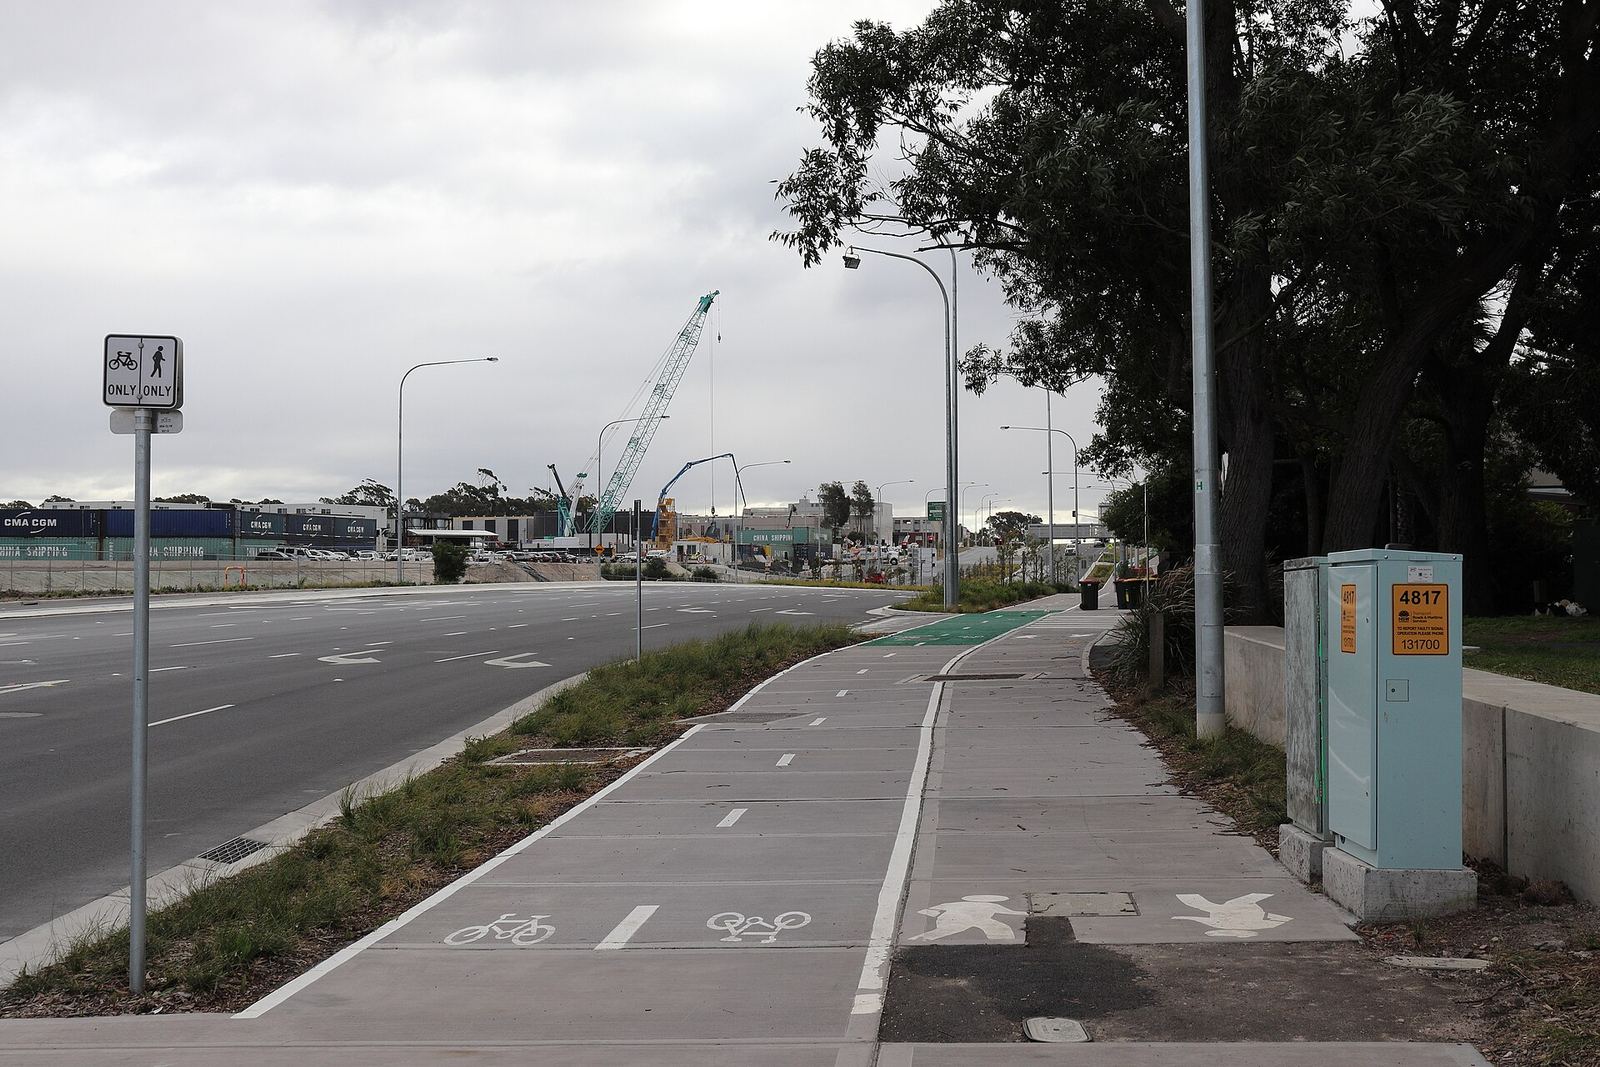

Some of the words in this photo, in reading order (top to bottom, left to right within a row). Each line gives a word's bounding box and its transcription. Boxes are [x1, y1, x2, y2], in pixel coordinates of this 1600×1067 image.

[108, 384, 136, 396] ONLY
[143, 385, 172, 397] ONLY
[1196, 481, 1203, 490] H
[4, 518, 29, 527] CMA
[31, 518, 57, 527] CGM
[250, 521, 261, 529] CMA
[26, 546, 68, 557] SHIPPING
[163, 546, 204, 557] SHIPPING
[1343, 590, 1354, 605] 4817
[1400, 590, 1441, 605] 4817
[1402, 639, 1440, 650] 131700
